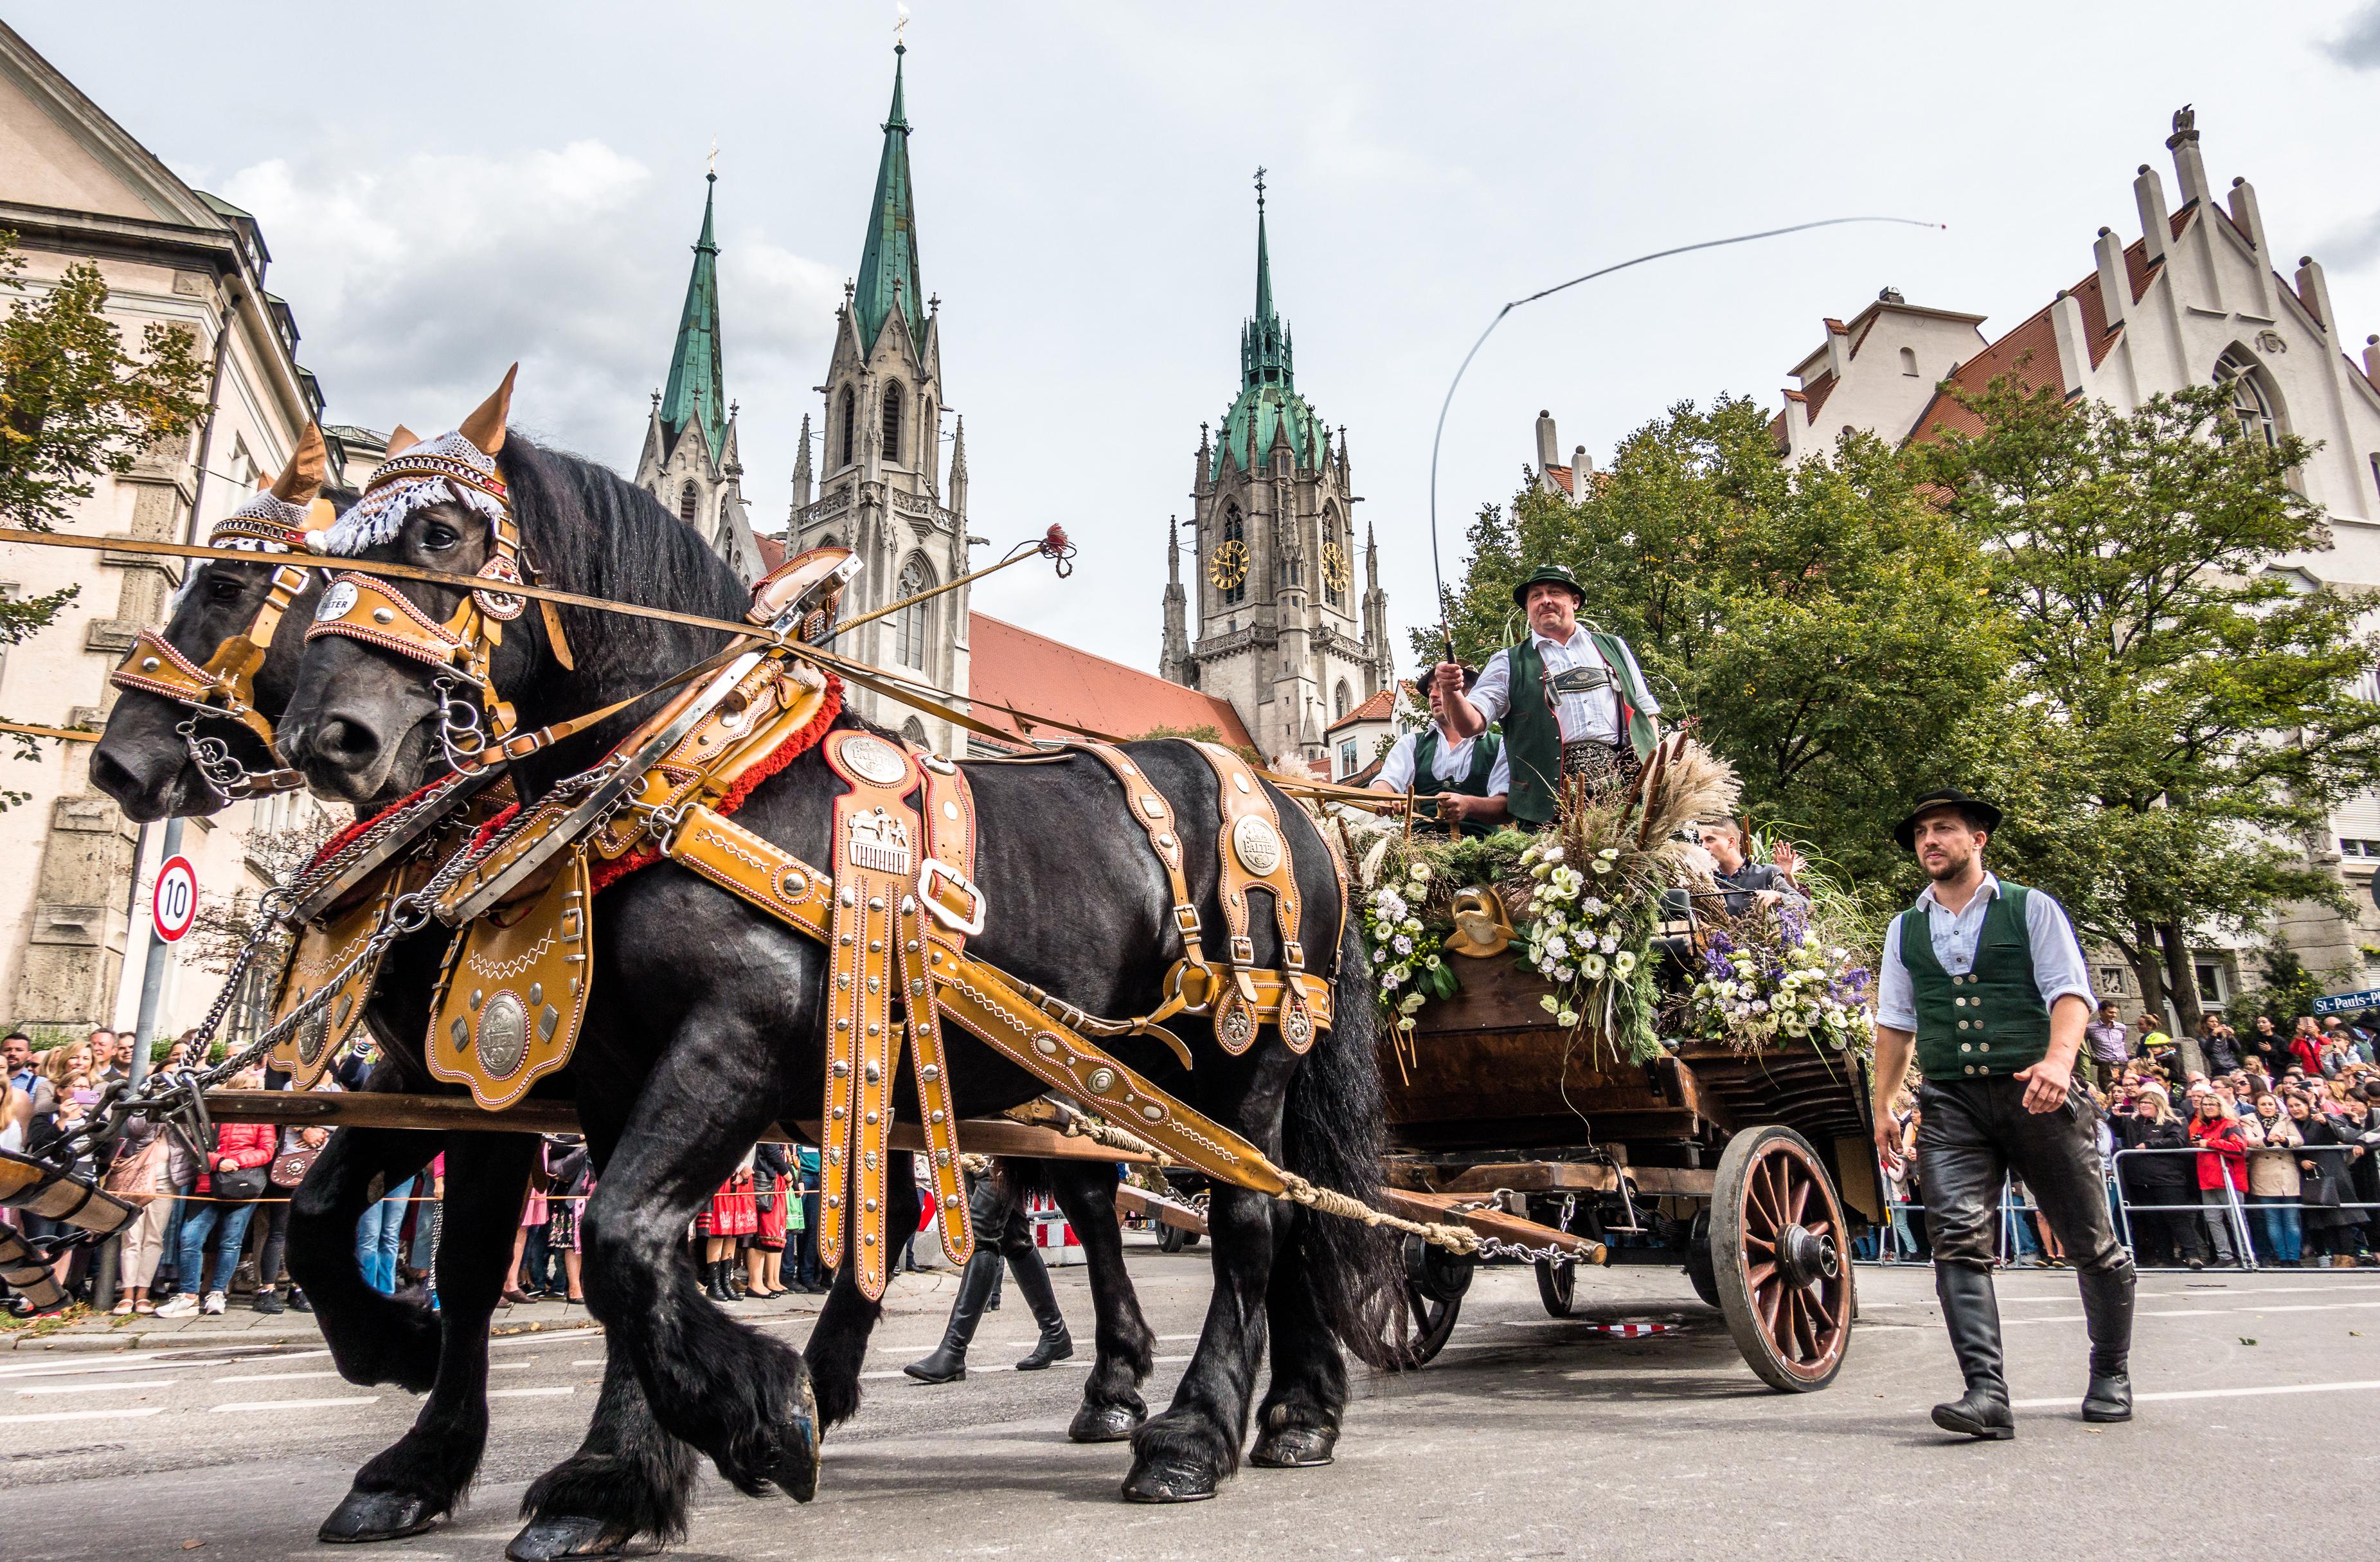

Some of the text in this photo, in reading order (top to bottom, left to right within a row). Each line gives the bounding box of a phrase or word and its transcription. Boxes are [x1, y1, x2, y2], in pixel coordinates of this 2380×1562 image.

[852, 749, 897, 769] FALTER
[1243, 840, 1276, 856] FALTER
[166, 878, 187, 919] 10
